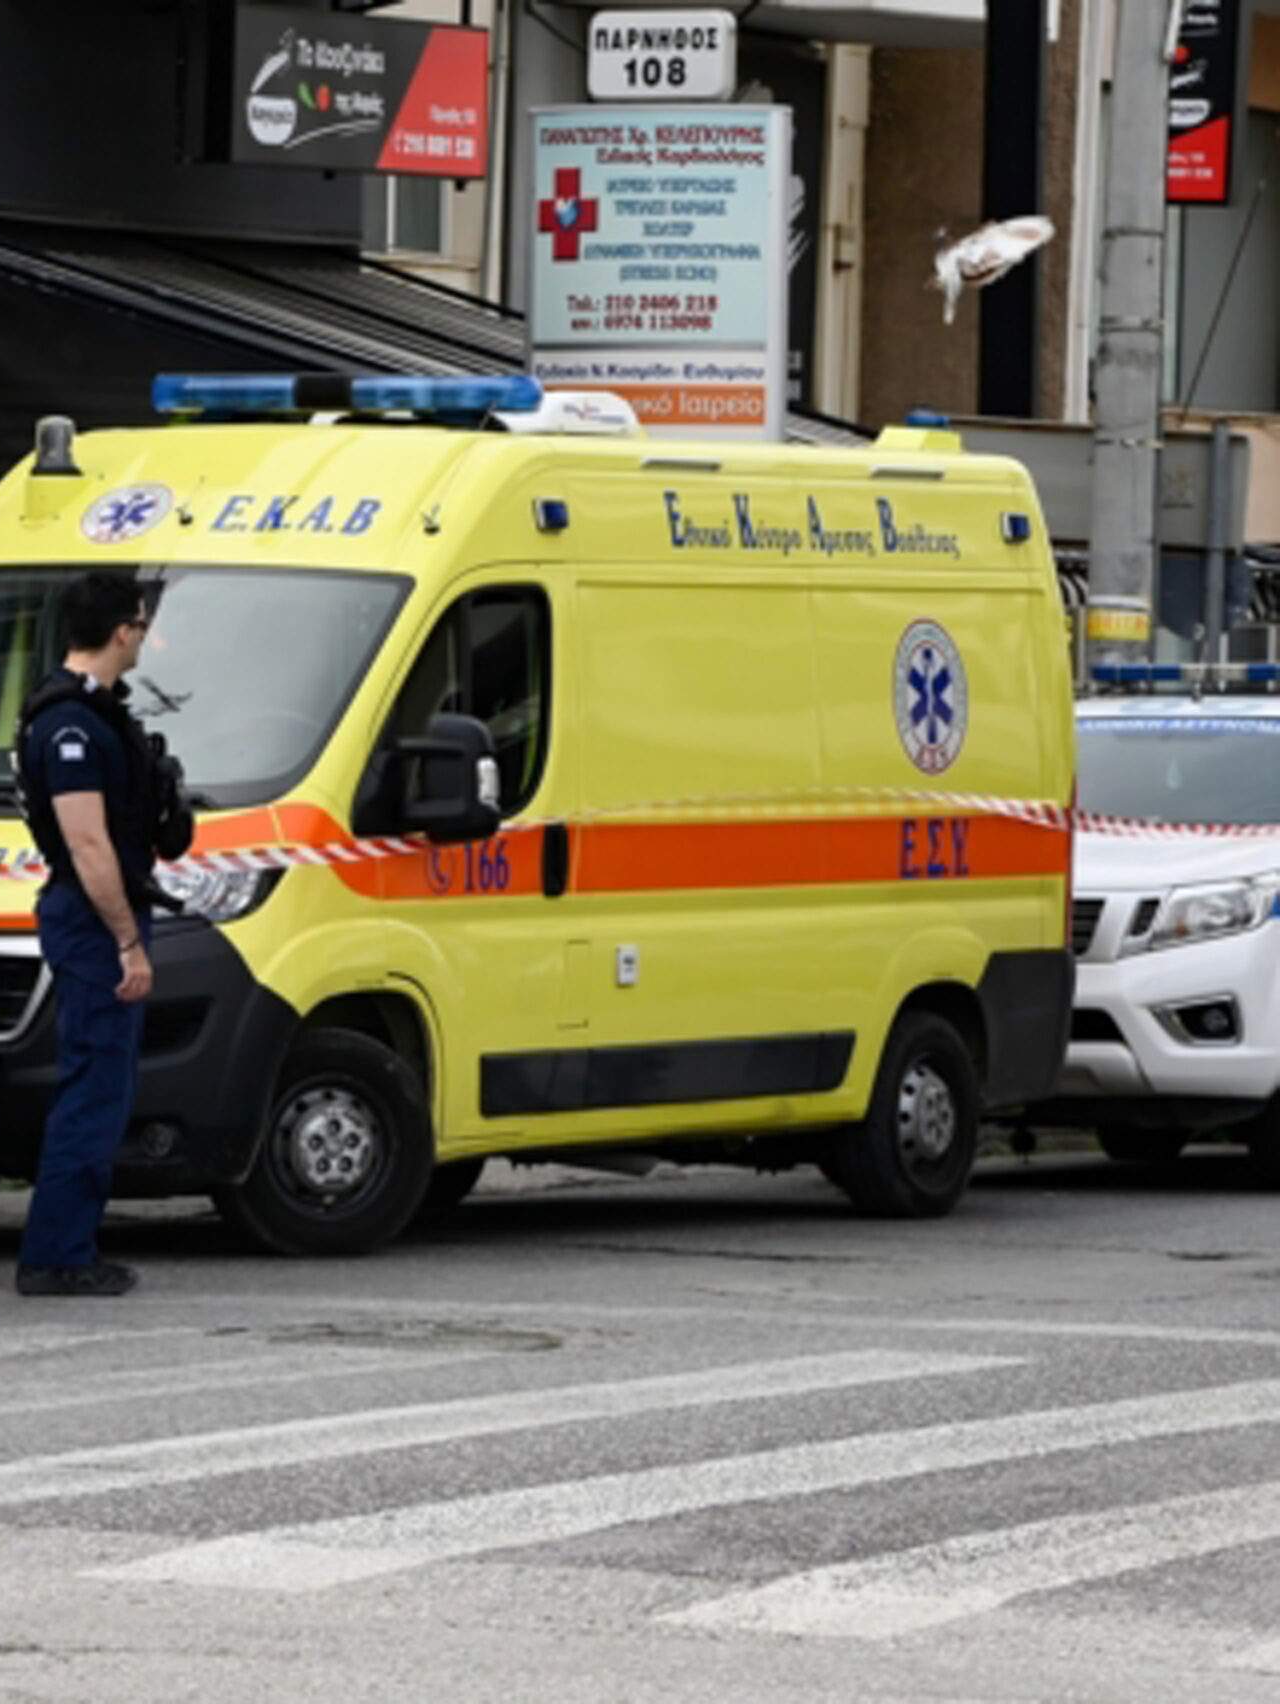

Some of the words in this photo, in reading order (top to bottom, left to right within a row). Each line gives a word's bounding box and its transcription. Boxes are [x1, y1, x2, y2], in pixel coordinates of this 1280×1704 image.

[594, 27, 720, 51] ΠΑΡΝΗΘΟΣ
[623, 57, 687, 87] 108
[605, 295, 636, 312] 210
[463, 838, 509, 891] 166
